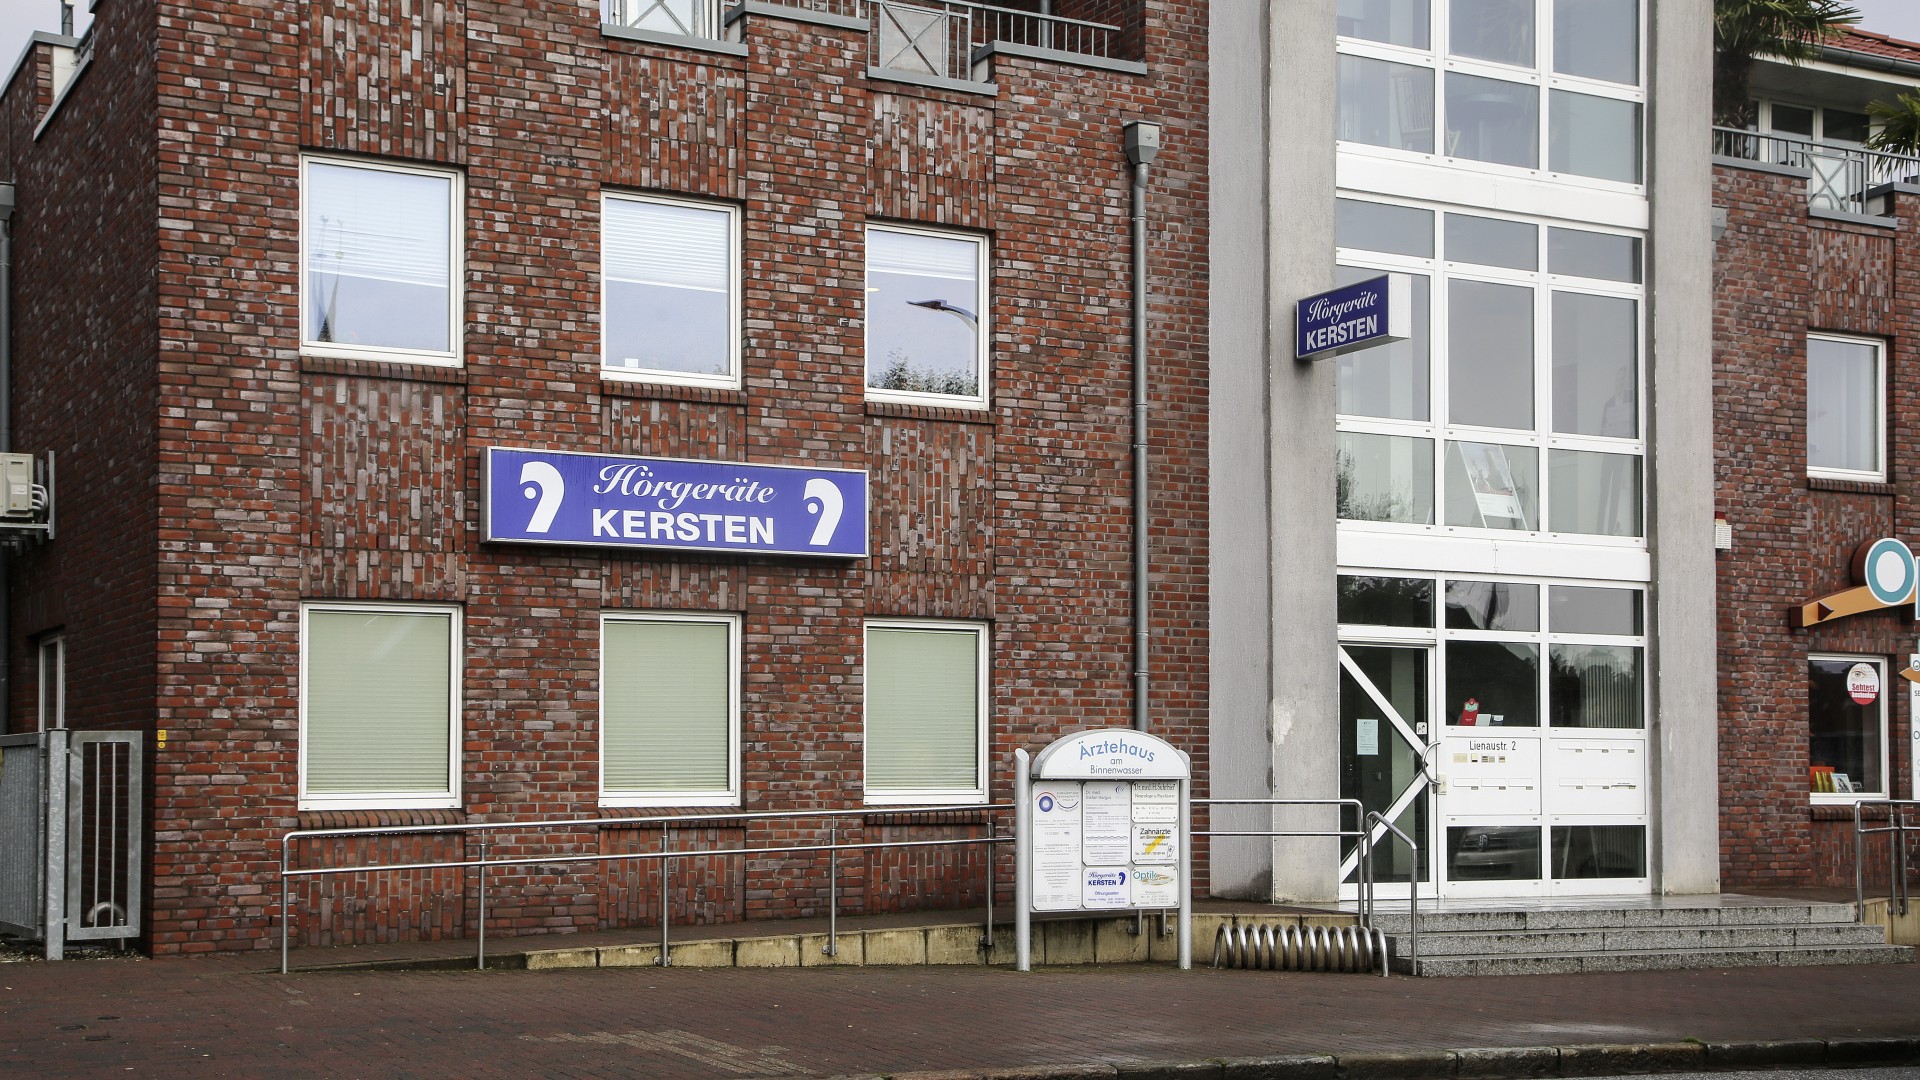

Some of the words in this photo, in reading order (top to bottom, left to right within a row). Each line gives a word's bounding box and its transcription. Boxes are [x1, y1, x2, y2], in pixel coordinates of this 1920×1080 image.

[1306, 291, 1378, 324] Hörgeräte
[1306, 314, 1378, 351] KERSTEN
[592, 463, 778, 510] Hörgeräte
[592, 507, 775, 545] KERSTEN
[1851, 683, 1875, 691] Sehtest
[1078, 738, 1155, 762] Ärztehaus
[1469, 740, 1508, 751] Lienaustr.
[1511, 740, 1517, 751] 2
[1090, 765, 1143, 775] Binnenwasser
[1140, 827, 1171, 835] Zahnärzte
[1088, 871, 1117, 879] Hörgeräte
[1133, 870, 1157, 880] Optik
